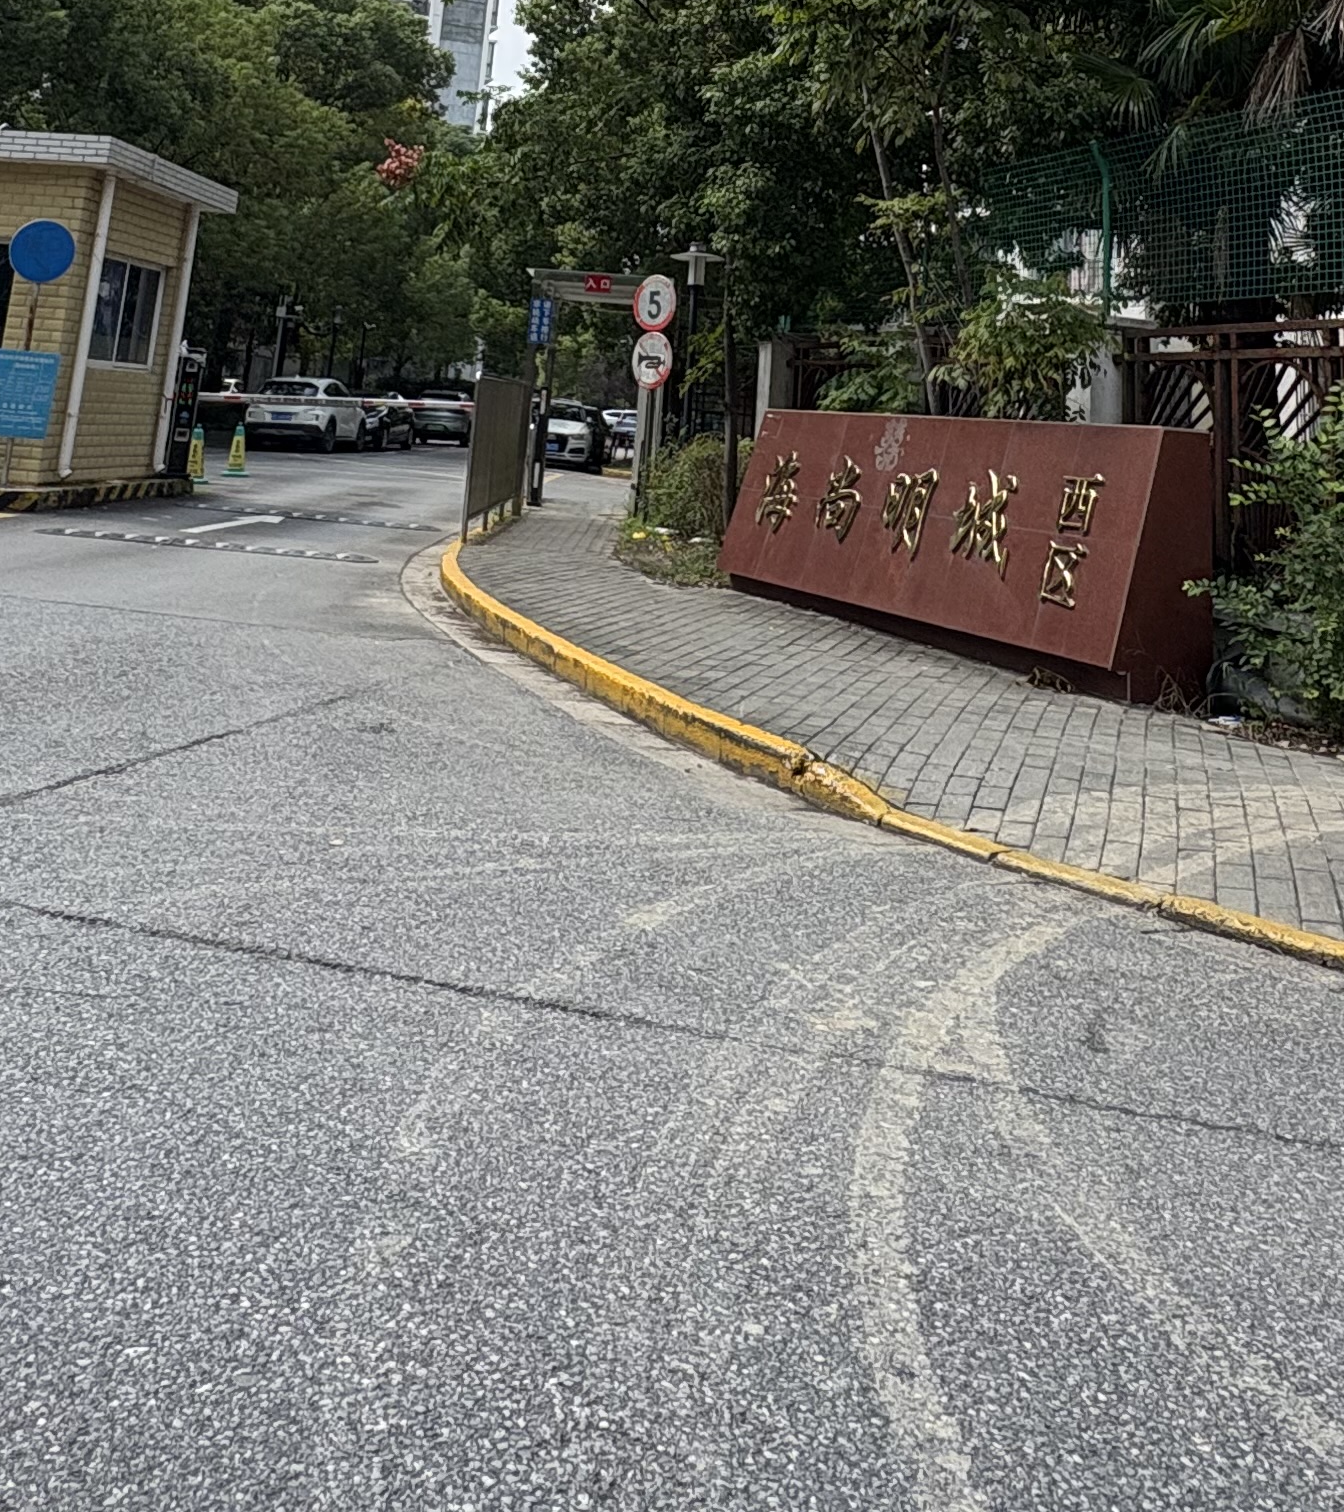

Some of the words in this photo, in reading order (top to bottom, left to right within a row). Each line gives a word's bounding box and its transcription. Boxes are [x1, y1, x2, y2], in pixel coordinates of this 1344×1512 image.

[585, 278, 610, 289] 入口
[647, 290, 662, 319] 5
[754, 450, 1020, 582] 海尚明城
[1039, 471, 1107, 609] 西区
